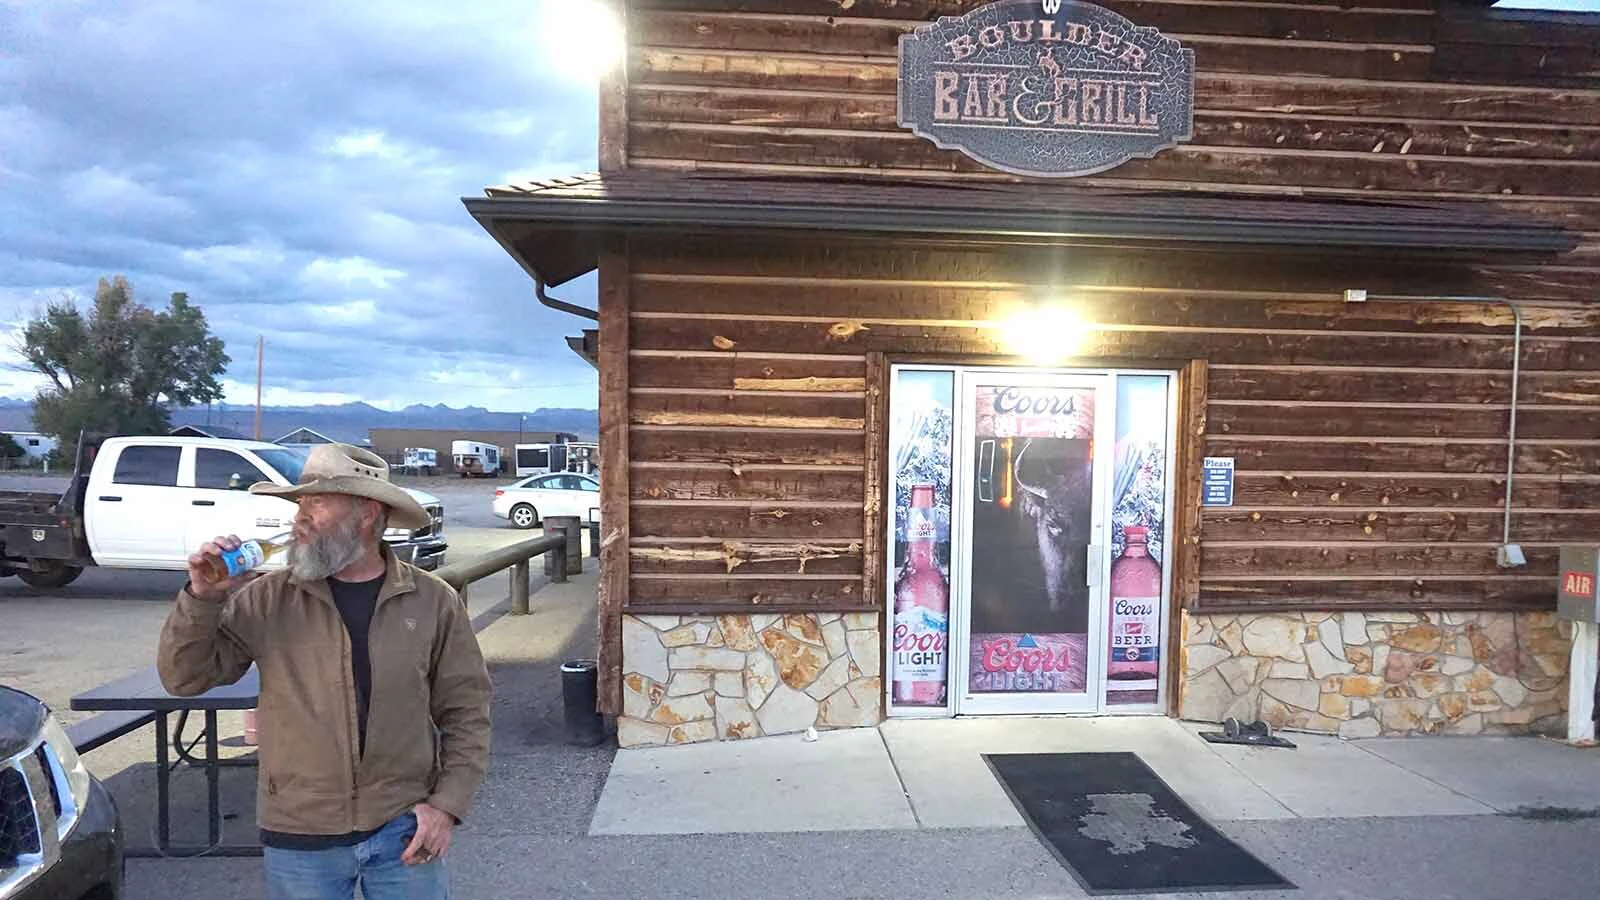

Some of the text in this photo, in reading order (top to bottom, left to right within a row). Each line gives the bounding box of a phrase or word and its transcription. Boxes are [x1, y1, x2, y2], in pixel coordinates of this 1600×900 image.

[945, 19, 1147, 68] BOULDER
[934, 71, 1159, 128] BAR & GRILL
[992, 386, 1076, 415] Coors
[1205, 459, 1232, 467] Please
[1566, 574, 1591, 594] AIR
[1115, 599, 1152, 616] Coors
[893, 624, 946, 652] Coor
[1114, 635, 1152, 645] BEER
[899, 652, 942, 665] LIGHT
[982, 638, 1073, 673] Coors
